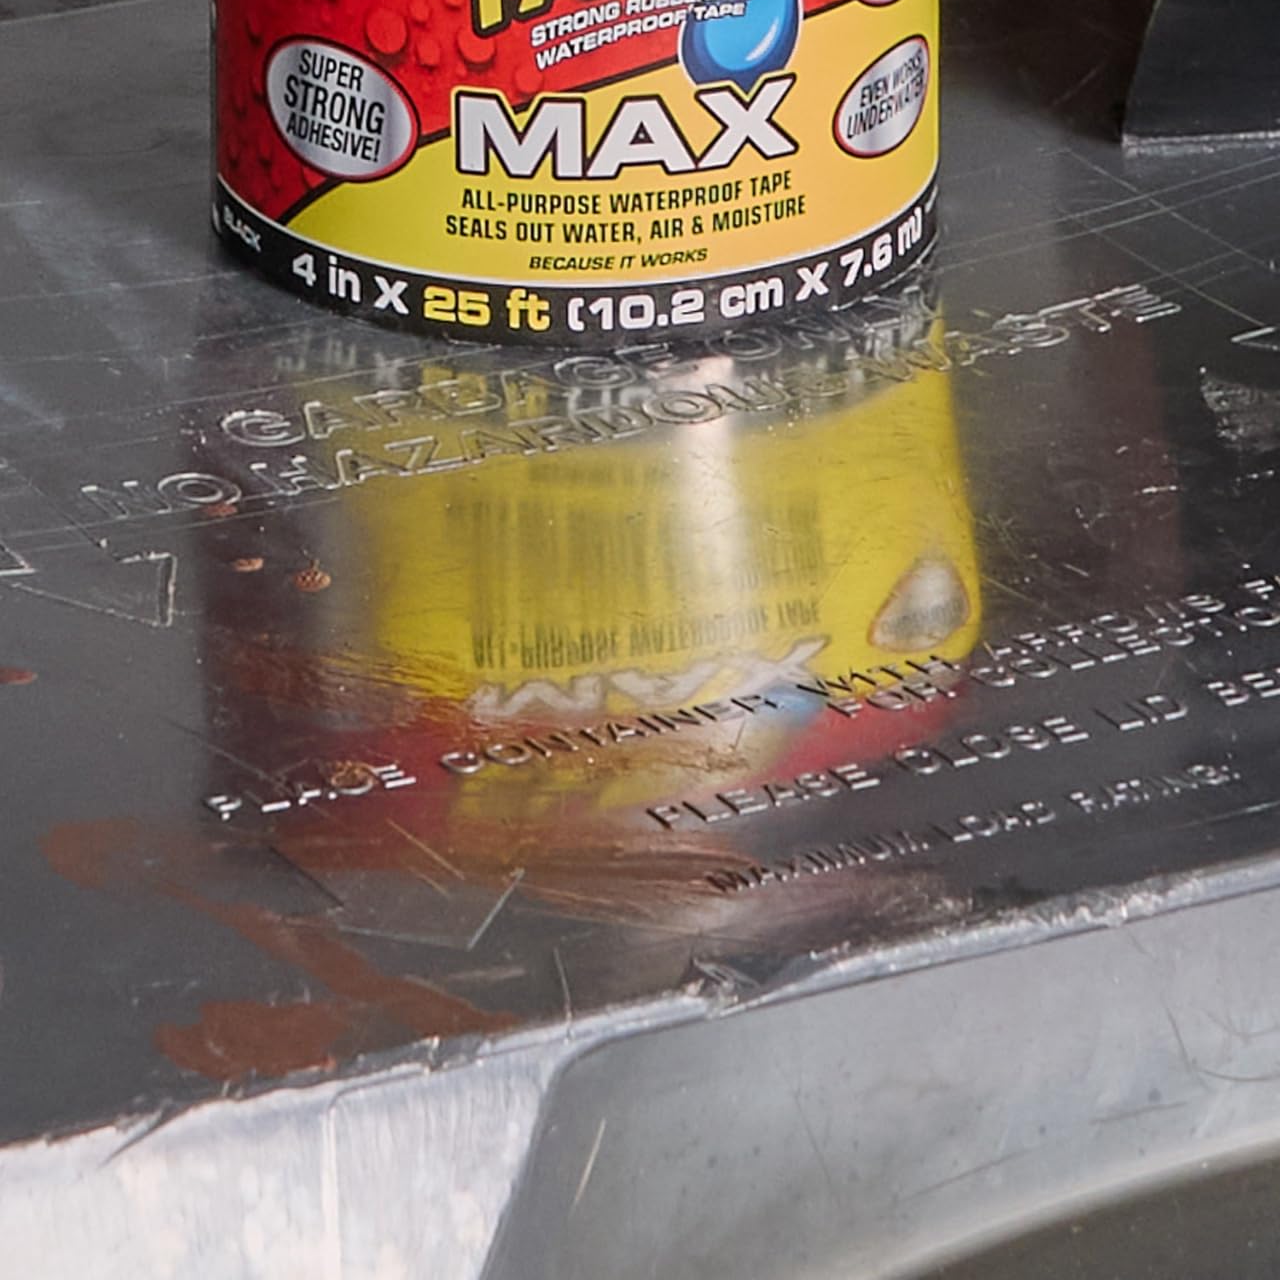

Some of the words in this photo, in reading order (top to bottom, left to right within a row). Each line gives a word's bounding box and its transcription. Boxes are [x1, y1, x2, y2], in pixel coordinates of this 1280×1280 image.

[531, 1, 621, 48] STRONG
[536, 7, 689, 70] WATERPROOF
[694, 2, 747, 22] TAPE
[299, 49, 364, 93] SUPER
[284, 74, 385, 136] STRONG
[457, 73, 799, 180] MAX
[286, 116, 381, 164] ADHESIVE!
[462, 187, 601, 216] ALL-PURPOSE
[609, 180, 744, 214] WATERPROOF
[750, 170, 793, 198] TAPE
[446, 215, 507, 241] SEALS
[516, 222, 553, 244] OUT
[563, 222, 643, 246] WATER,
[650, 217, 683, 240] AIR
[692, 215, 704, 236] &
[711, 195, 806, 233] MOISTURE
[292, 252, 317, 287] 4
[328, 255, 361, 303] in
[423, 286, 491, 328] 25
[506, 289, 551, 332] ft
[567, 288, 705, 331] (10.2
[720, 275, 783, 319] cm
[838, 231, 894, 288] 7.6
[897, 205, 922, 257] m)
[529, 252, 613, 271] BECAUSE
[619, 252, 636, 270] IT
[640, 246, 709, 268] WORKS
[81, 471, 242, 520] NO
[826, 680, 957, 719] FOR
[439, 692, 784, 774] CONTAINER
[647, 762, 880, 831] PLEASE
[895, 716, 1090, 776] CLOSE
[1096, 692, 1189, 732] LID
[935, 802, 1057, 845] LOAD
